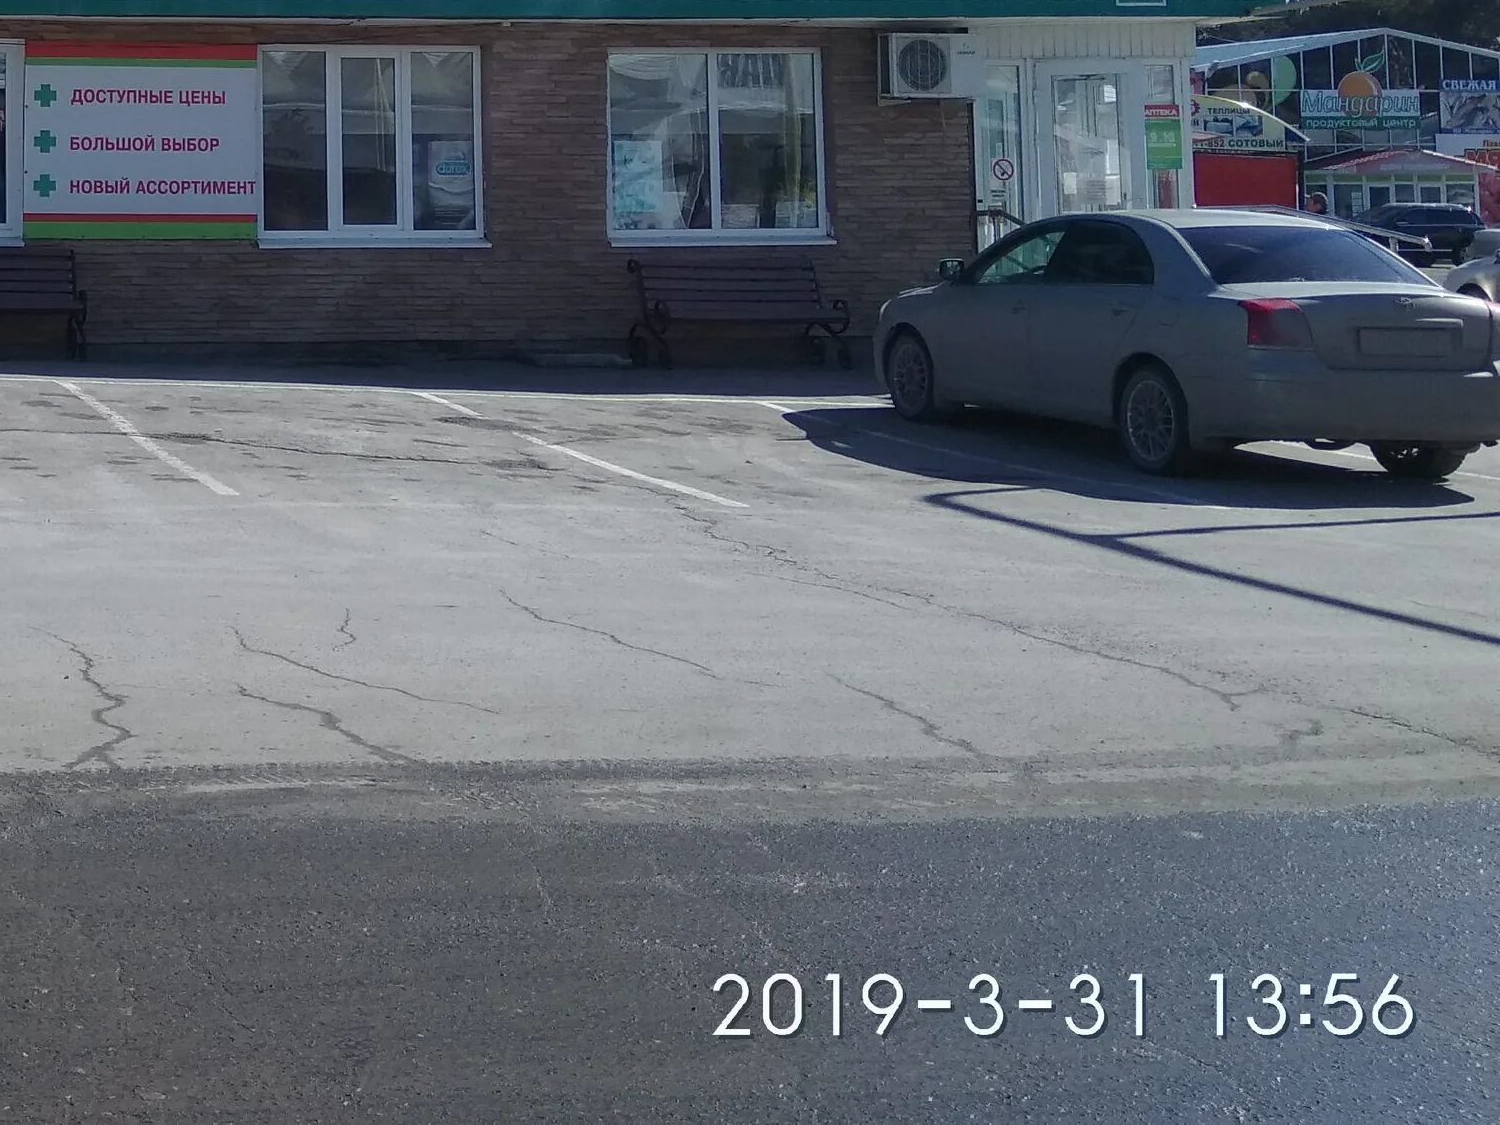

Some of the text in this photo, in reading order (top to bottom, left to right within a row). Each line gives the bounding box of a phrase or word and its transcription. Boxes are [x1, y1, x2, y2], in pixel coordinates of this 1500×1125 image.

[1442, 80, 1496, 90] СВЕЖАЯ
[71, 89, 226, 106] ДОСТУПНЫЕ ЦЕНЫ
[1302, 90, 1419, 117] Мандарин
[1208, 106, 1251, 115] ТЕПЛИЦЫ
[1306, 118, 1417, 130] продуктовый центр
[70, 134, 220, 152] БОЛЬШОЙ ВЫБОР
[1228, 138, 1284, 148] СОТОВЫЙ
[437, 161, 470, 174] durex
[70, 177, 256, 195] НОВЫЙ АССОРТИМЕНТ
